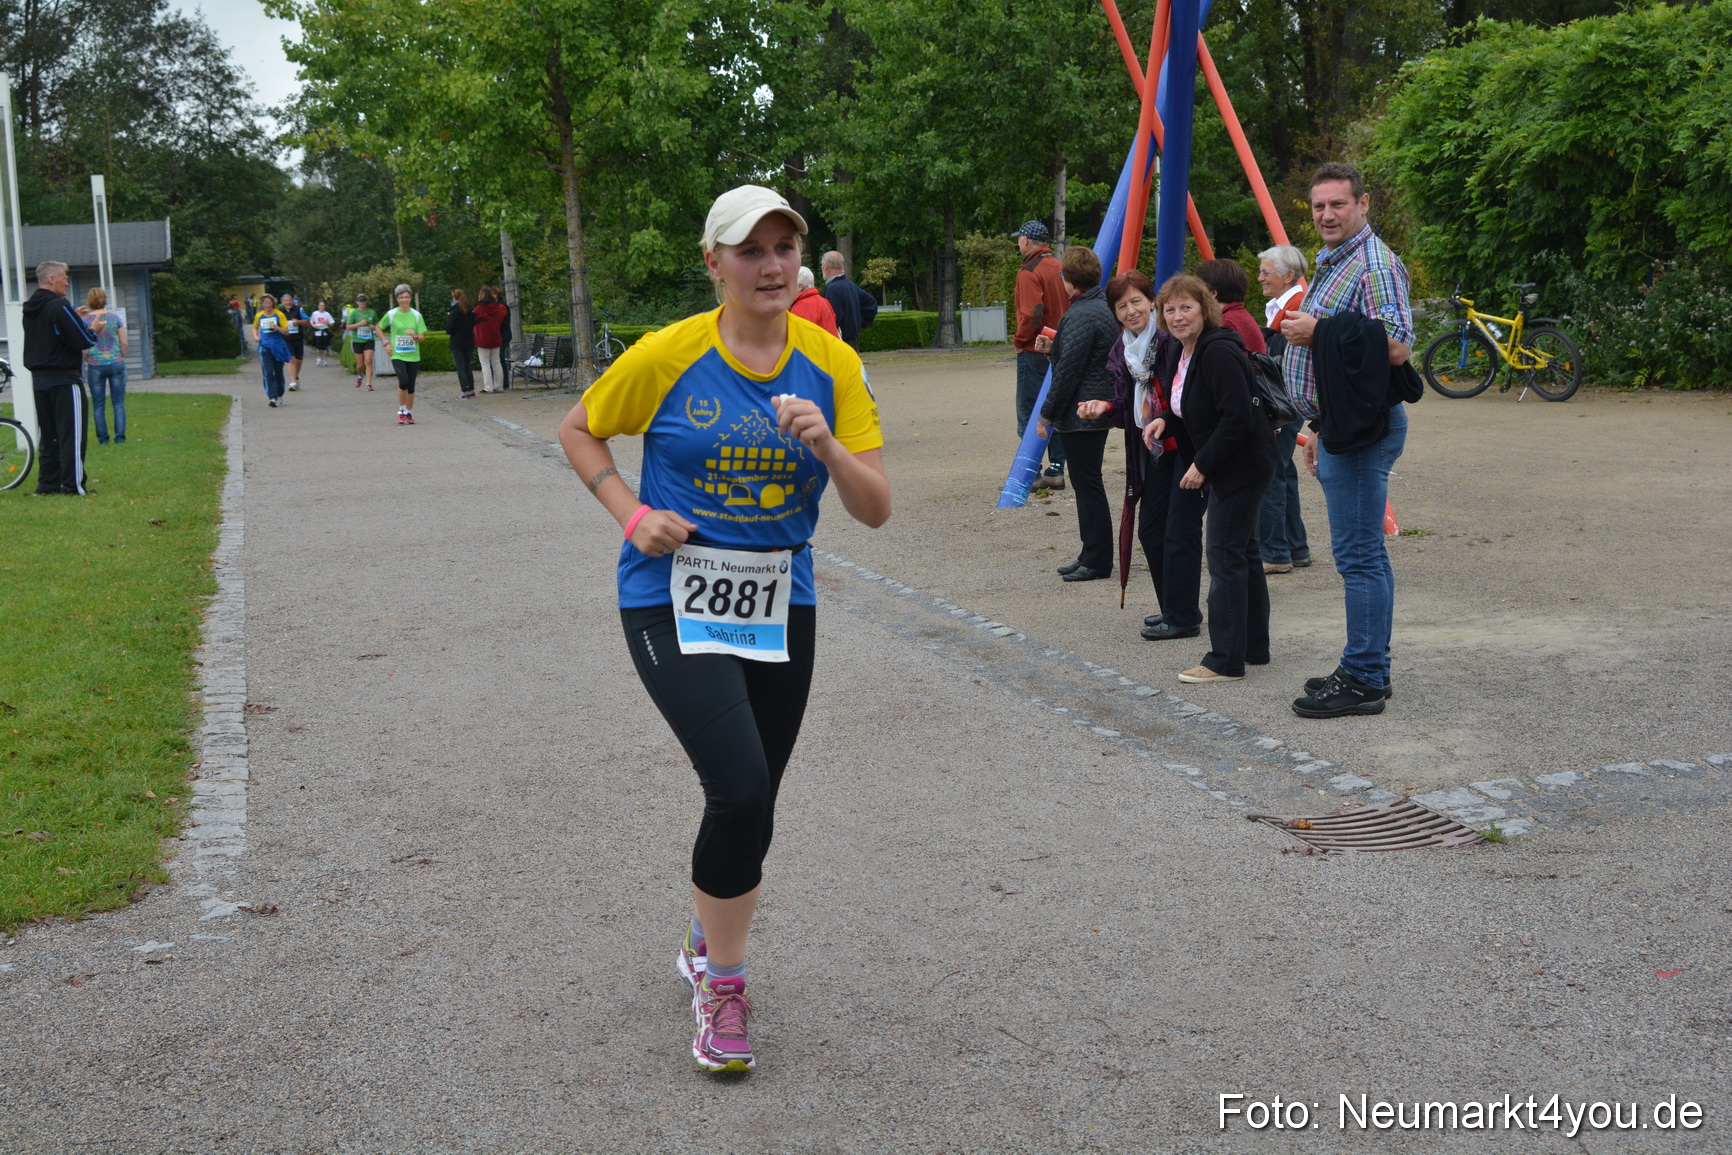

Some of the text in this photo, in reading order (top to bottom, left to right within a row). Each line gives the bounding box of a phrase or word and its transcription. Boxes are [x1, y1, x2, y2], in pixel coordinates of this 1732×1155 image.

[676, 555, 776, 574] PARTL Neumarkt
[684, 575, 778, 618] 2881
[705, 625, 757, 646] Sabrina
